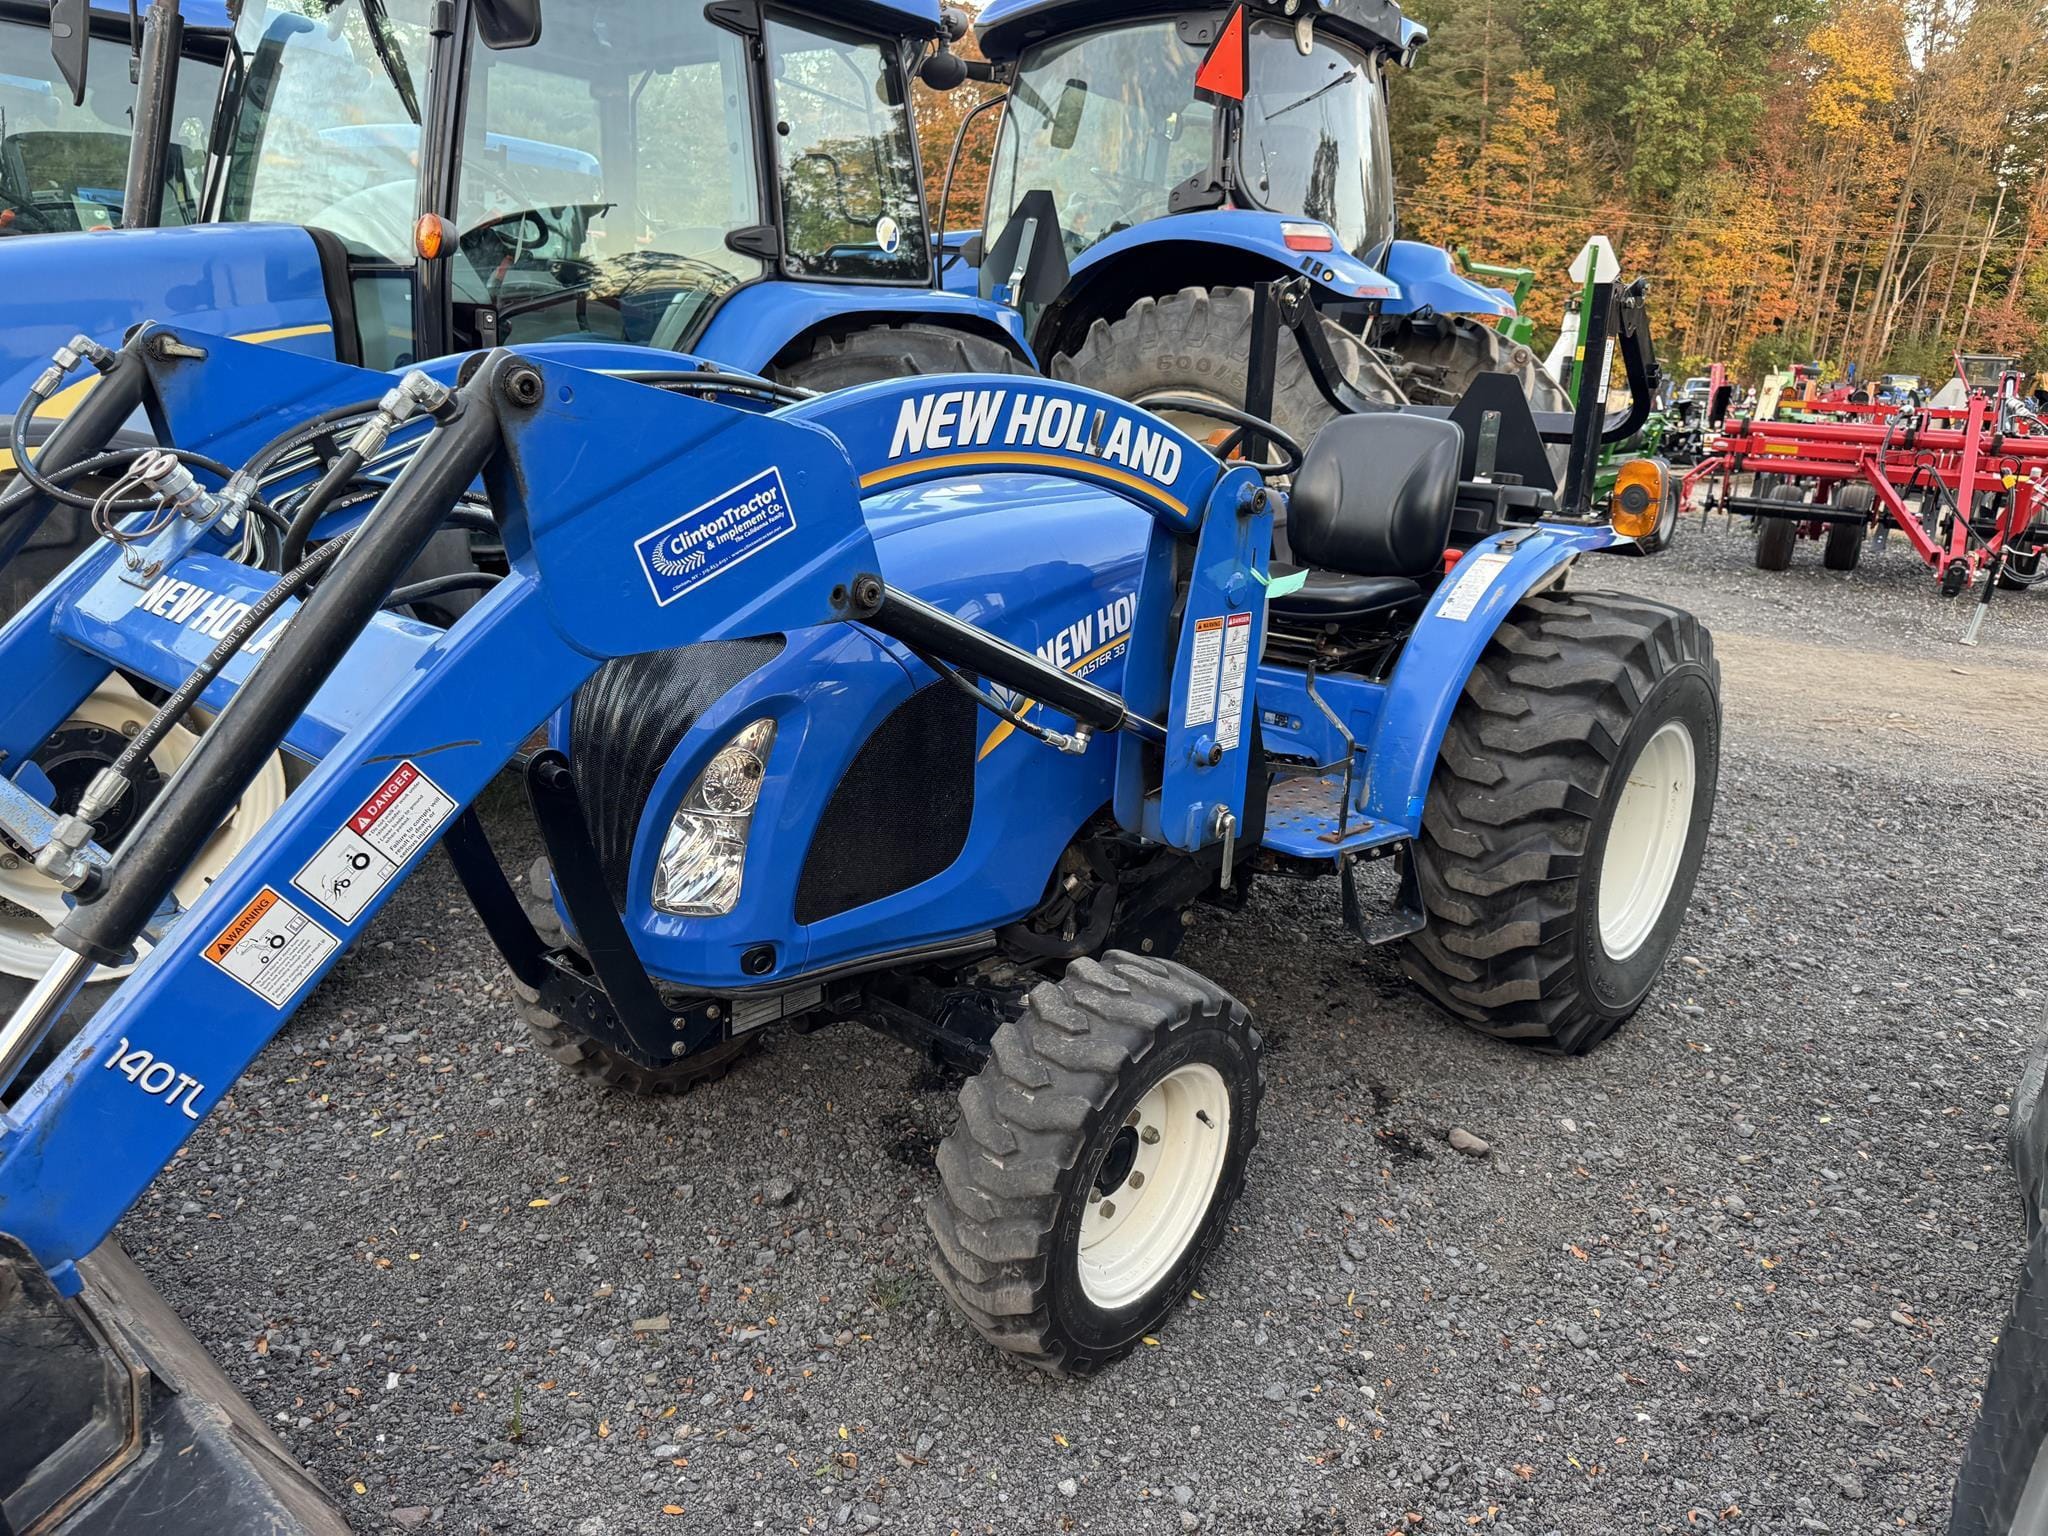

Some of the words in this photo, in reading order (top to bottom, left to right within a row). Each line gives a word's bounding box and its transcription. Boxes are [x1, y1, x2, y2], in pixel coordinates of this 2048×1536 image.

[888, 390, 1007, 459] NEW
[1004, 394, 1182, 486] HOLLAND
[706, 540, 715, 550] &
[716, 511, 766, 545] Implement
[768, 503, 783, 516] Co.
[135, 574, 214, 624] NEW
[236, 616, 251, 634] SAE
[1036, 614, 1092, 669] NEW
[1113, 643, 1126, 659] 33
[180, 672, 204, 694] Flame
[368, 770, 412, 816] DANGER
[388, 832, 407, 851] Failure
[411, 806, 431, 827] comply
[429, 796, 441, 808] will
[393, 838, 410, 855] result
[414, 816, 430, 833] death
[398, 838, 418, 859] serious
[416, 823, 432, 840] injury
[226, 898, 270, 943] WARNING
[104, 1037, 205, 1120] 140TL
